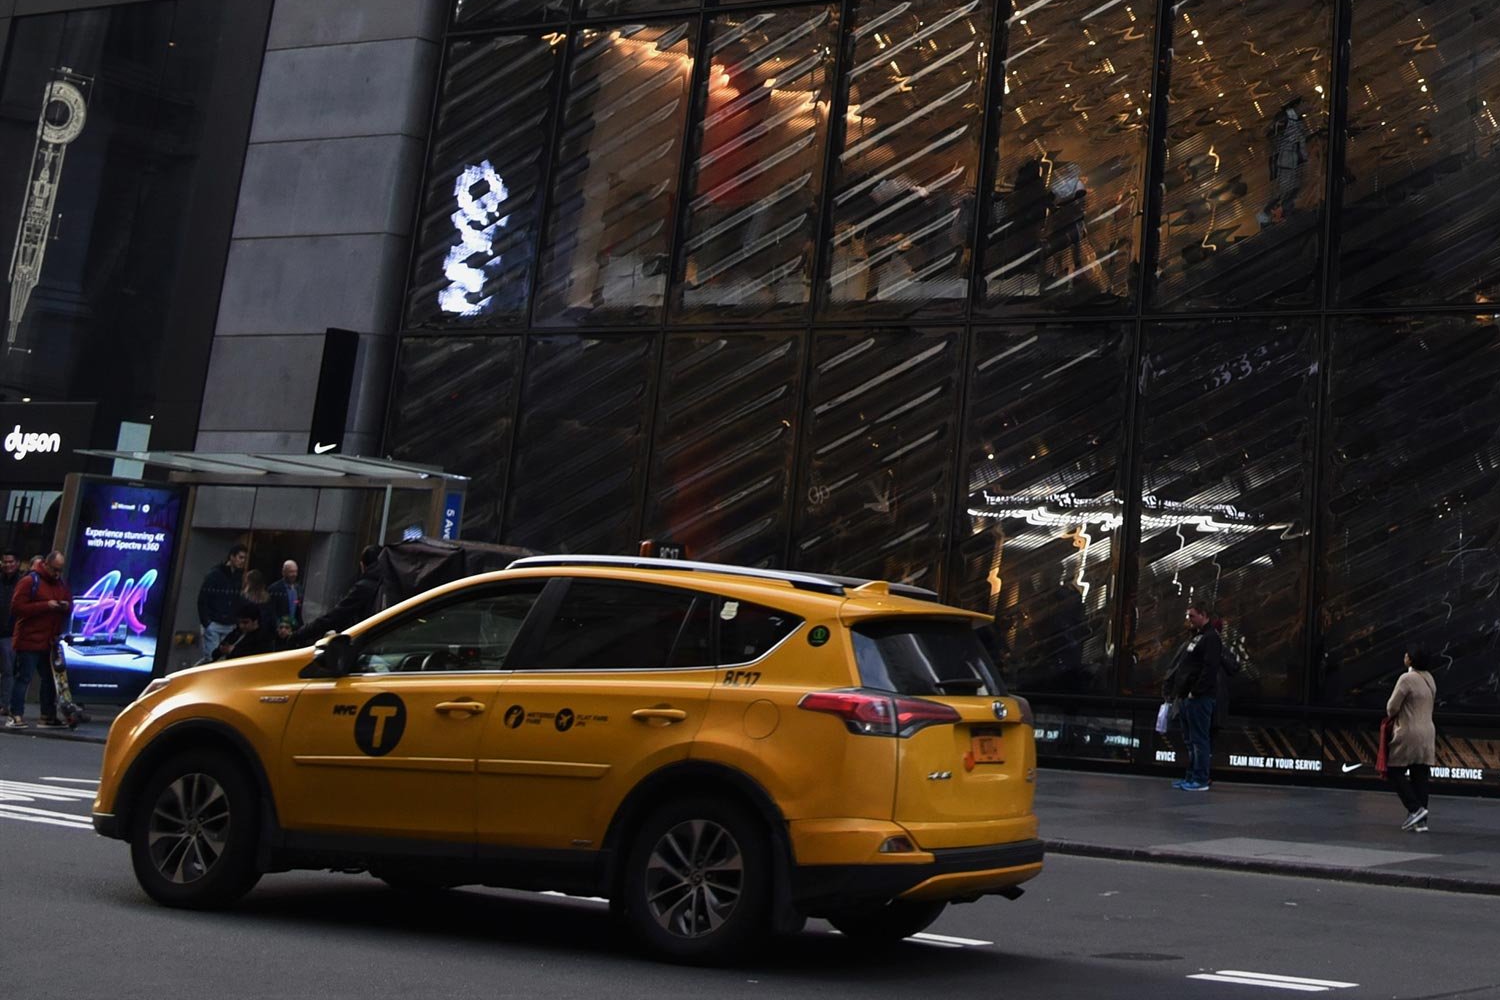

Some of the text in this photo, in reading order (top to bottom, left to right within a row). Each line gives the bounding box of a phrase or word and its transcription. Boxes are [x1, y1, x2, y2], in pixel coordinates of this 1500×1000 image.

[4, 424, 61, 461] dyson
[85, 527, 124, 539] Experience
[124, 531, 154, 542] stunning
[87, 539, 104, 547] with
[104, 540, 116, 548] HP
[73, 569, 158, 640] 4K
[333, 705, 398, 748] NYC T
[1229, 755, 1322, 771] TEAM NIKE AT YOUR SERVIC
[1430, 766, 1483, 780] YOUR SERVICE
